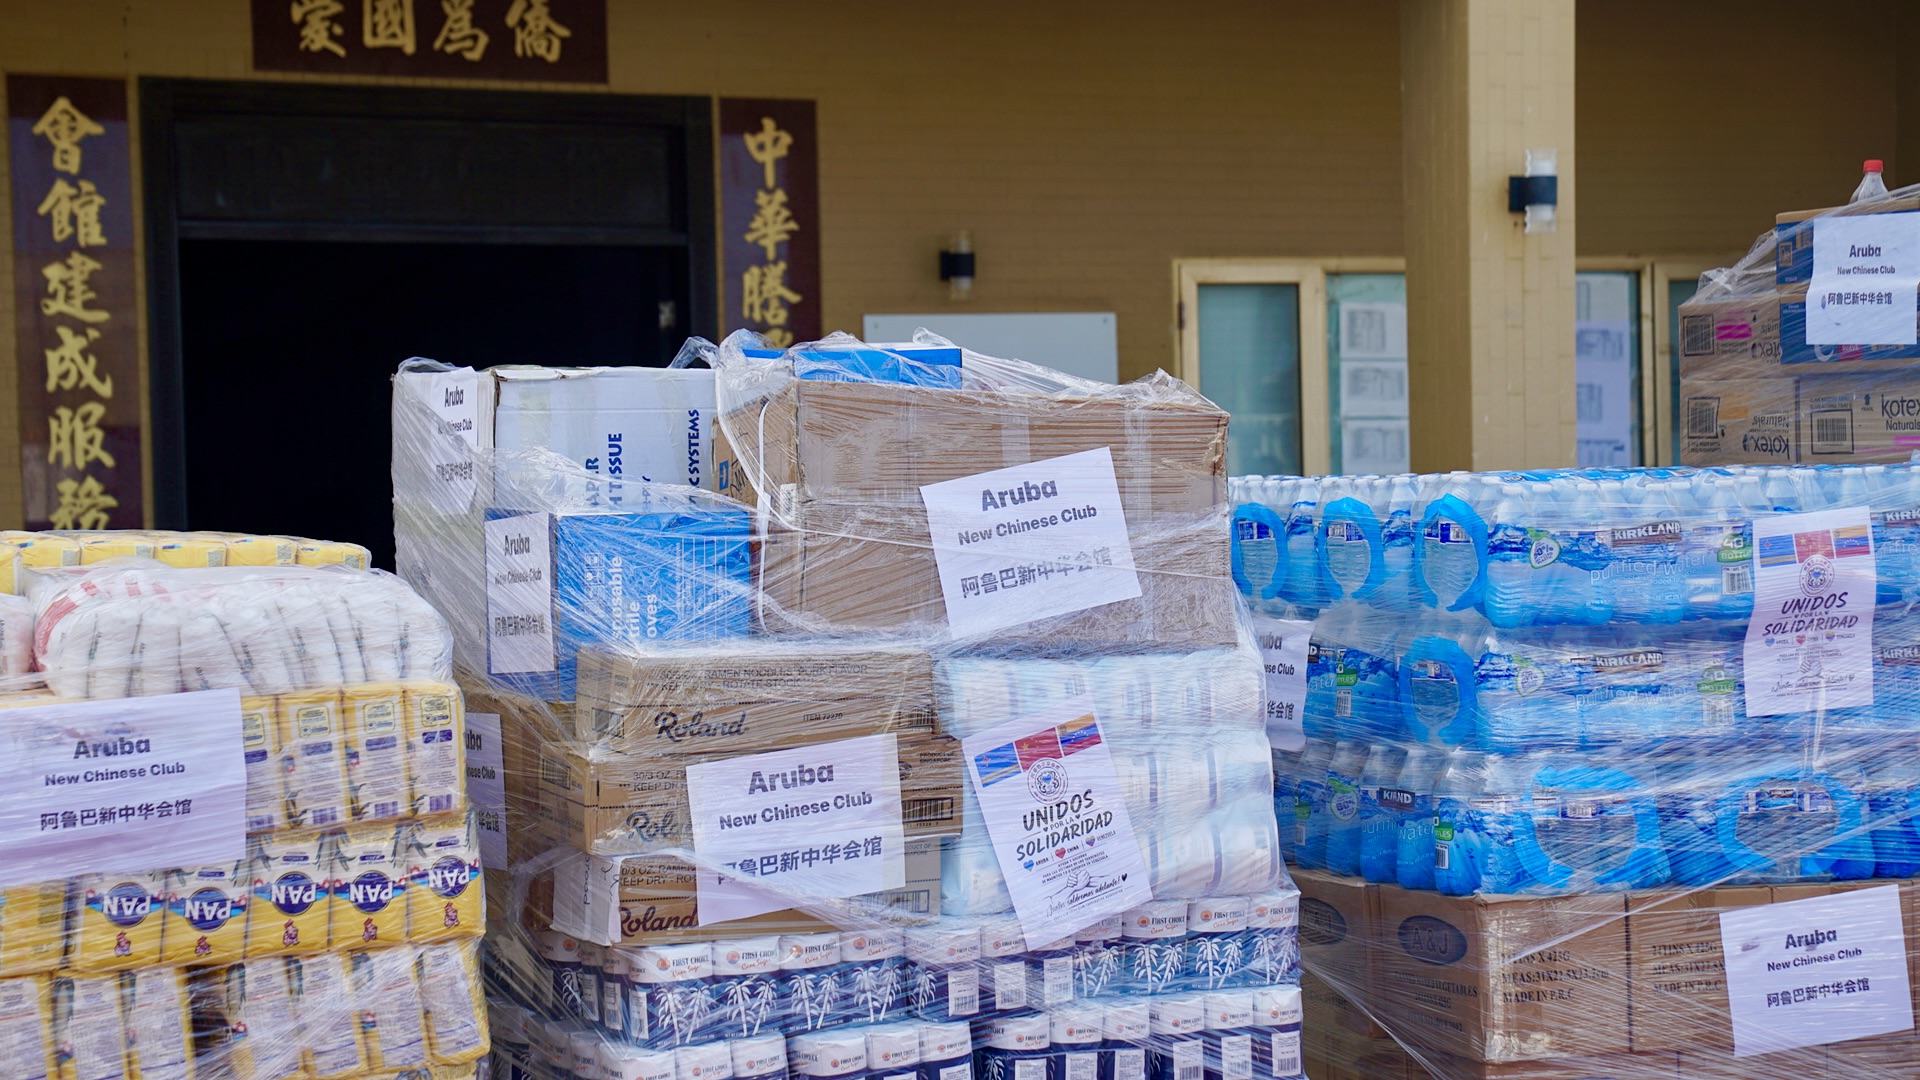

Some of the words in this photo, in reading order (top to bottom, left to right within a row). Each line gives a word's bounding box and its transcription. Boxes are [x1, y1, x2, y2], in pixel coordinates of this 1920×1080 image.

[1849, 244, 1881, 258] Aruba
[1837, 266, 1851, 275] New
[1853, 265, 1878, 274] Chinese
[1880, 265, 1895, 274] Club
[445, 386, 464, 407] Aruba
[463, 417, 472, 431] Club
[688, 409, 699, 475] SYSTEMS
[982, 479, 1058, 512] Aruba
[958, 527, 993, 546] New
[995, 514, 1059, 540] Chinese
[1061, 503, 1097, 523] Club
[1885, 507, 1920, 522] KIRK
[1614, 522, 1681, 541] KIRKLAND
[504, 534, 530, 556] Aruba
[1665, 553, 1706, 576] water
[1781, 591, 1848, 615] UNIDOS
[1762, 615, 1858, 636] SOLIDARIDAD
[1258, 631, 1282, 650] ruba
[1277, 663, 1294, 675] Club
[1596, 651, 1664, 667] KIRKLAND
[654, 711, 747, 742] Roland
[73, 737, 151, 760] Aruba
[466, 729, 482, 750] uba
[44, 774, 79, 787] New
[83, 768, 146, 783] Chinese
[150, 762, 185, 776] Club
[748, 764, 834, 795] Aruba
[633, 783, 662, 792] KEEP
[719, 812, 757, 830] New
[761, 801, 830, 823] Chinese
[833, 792, 872, 810] Club
[1023, 789, 1094, 831] UNIDOS
[1050, 821, 1064, 831] POR
[1066, 816, 1074, 826] LA
[1016, 810, 1113, 861] SOLIDARIDAD
[647, 876, 668, 885] DRY
[620, 906, 698, 937] Roland
[1152, 917, 1168, 925] FIRST
[1214, 911, 1228, 919] FIRST
[805, 945, 821, 953] FIRST
[1785, 929, 1837, 949] Aruba
[672, 957, 689, 967] FIRST
[690, 955, 709, 964] CHOICE
[1767, 961, 1790, 972] New
[1793, 953, 1835, 967] Chinese
[1838, 948, 1862, 959] Club
[1503, 992, 1533, 1003] MADE
